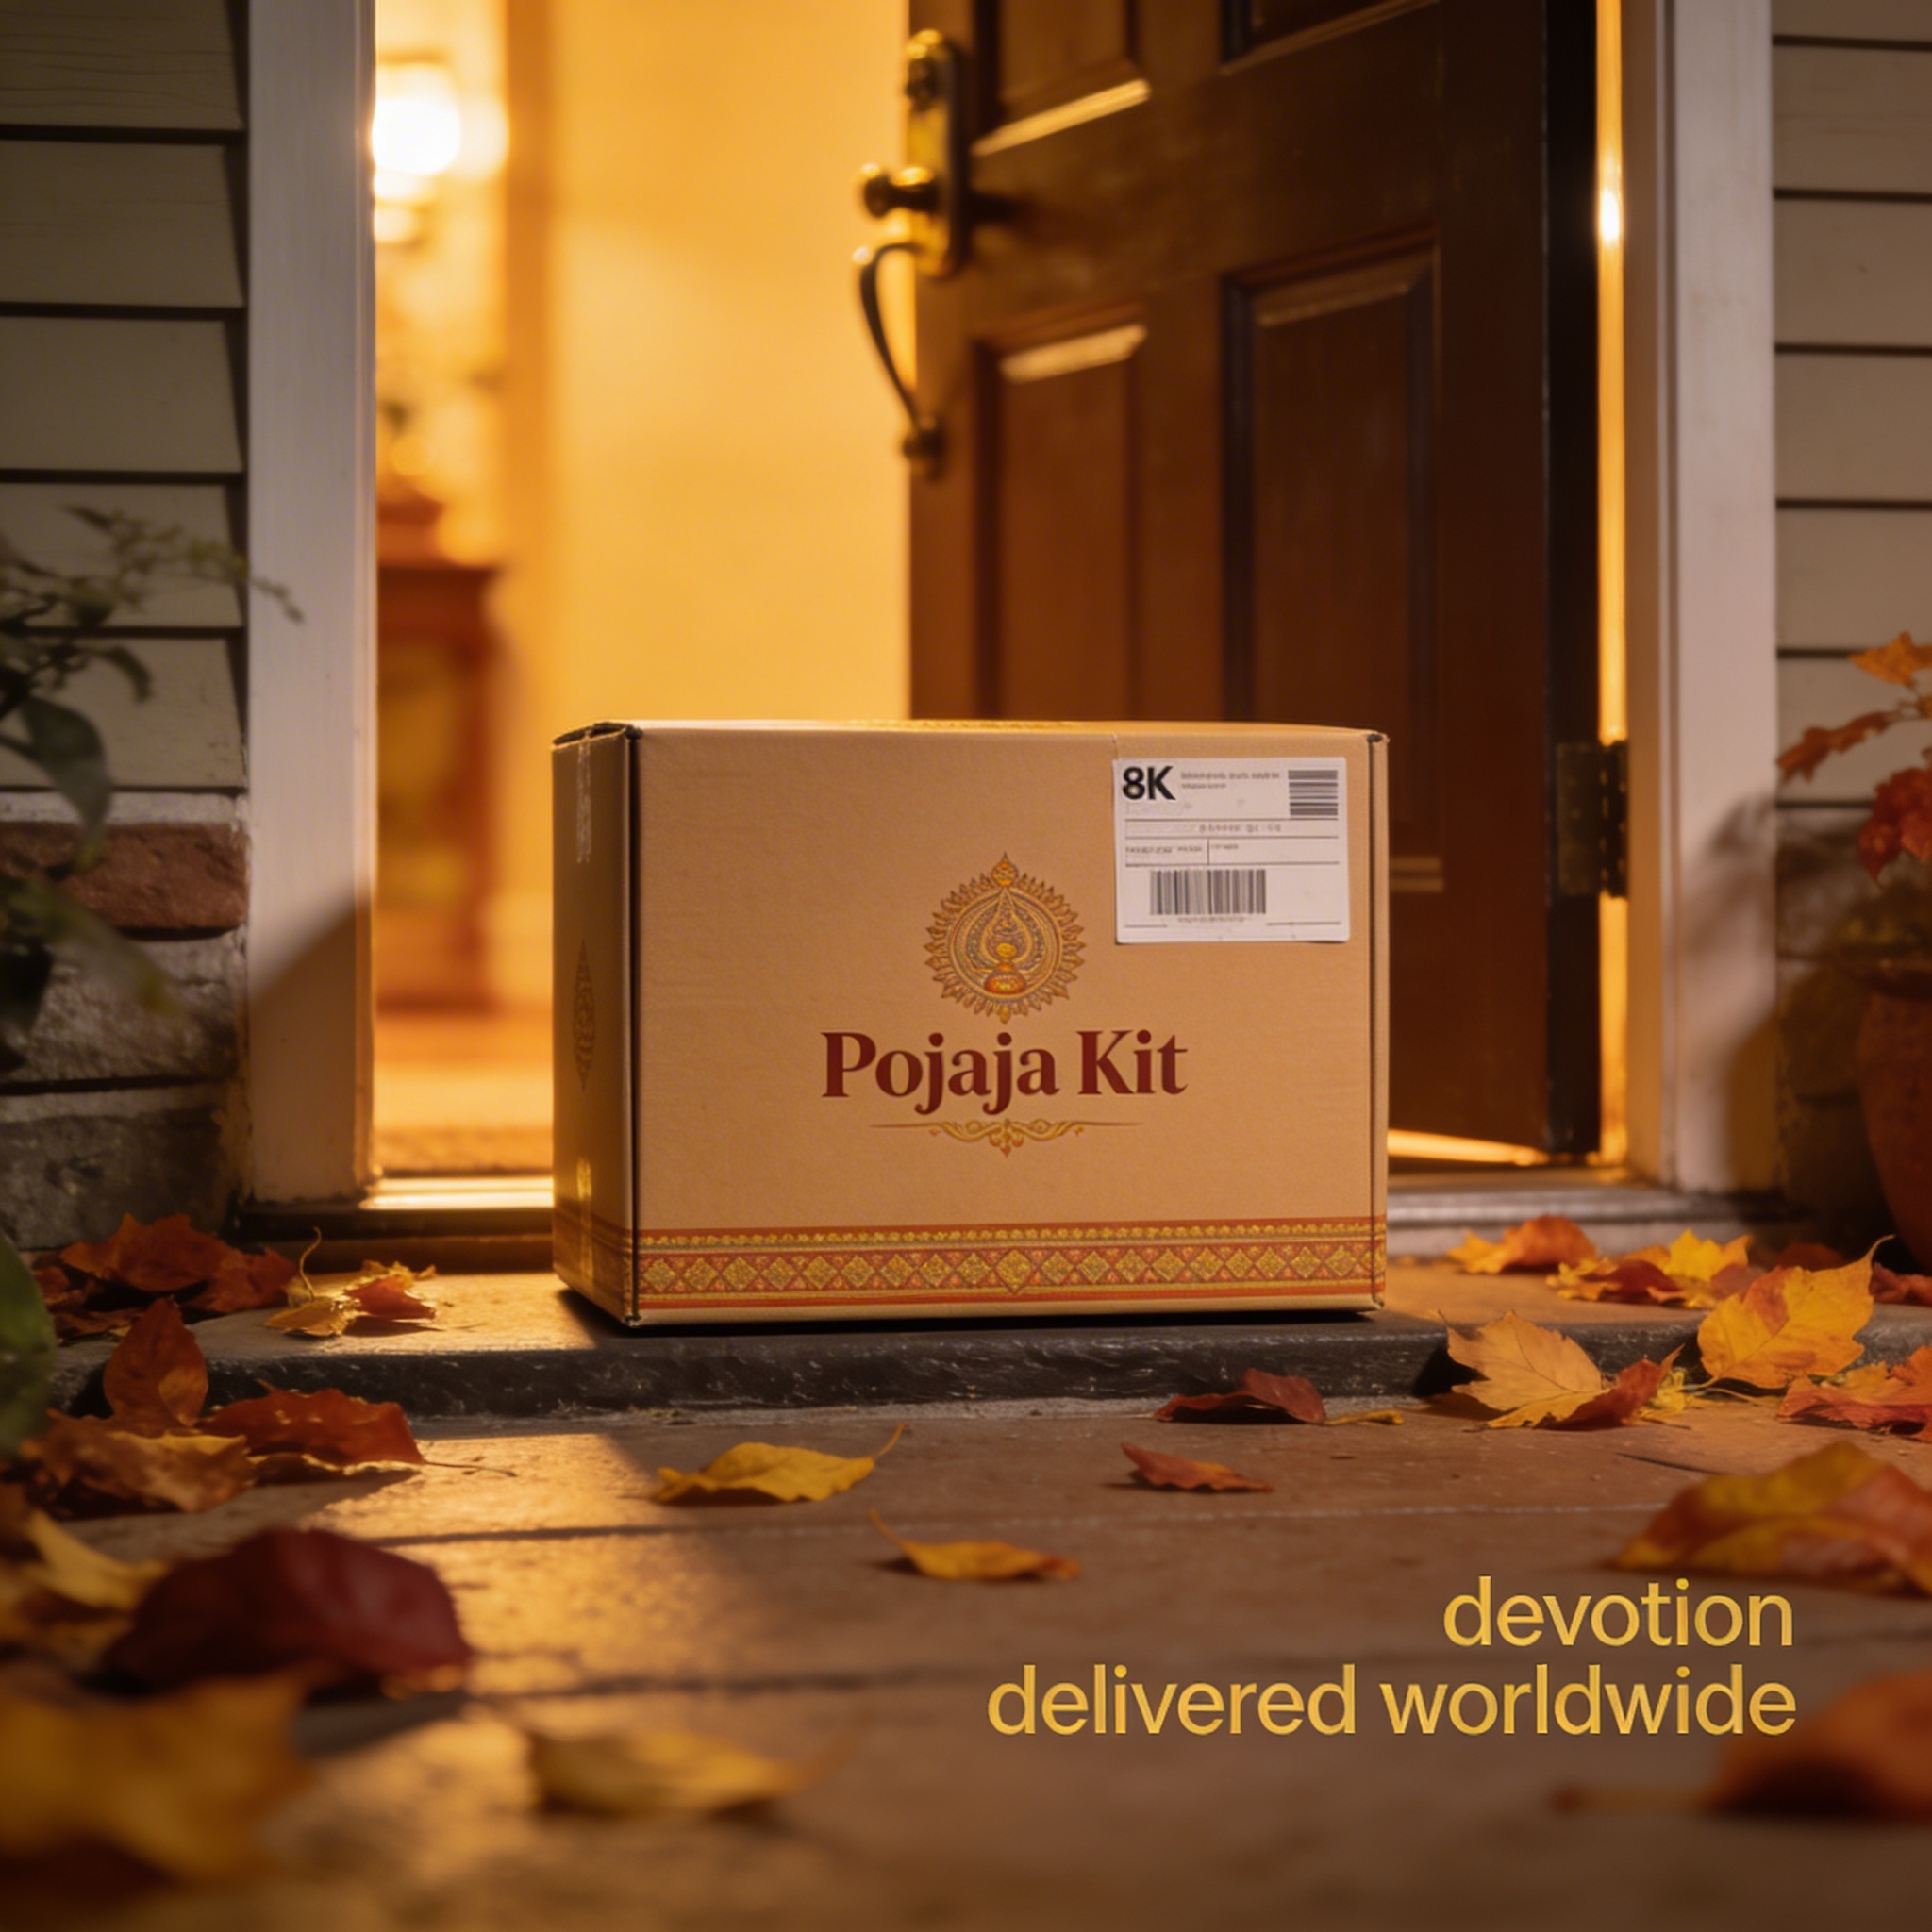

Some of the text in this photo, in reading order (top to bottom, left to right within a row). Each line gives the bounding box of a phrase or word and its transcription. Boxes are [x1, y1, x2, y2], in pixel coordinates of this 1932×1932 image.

[1123, 766, 1176, 800] 8K
[820, 1029, 1189, 1115] Pojaja Kit
